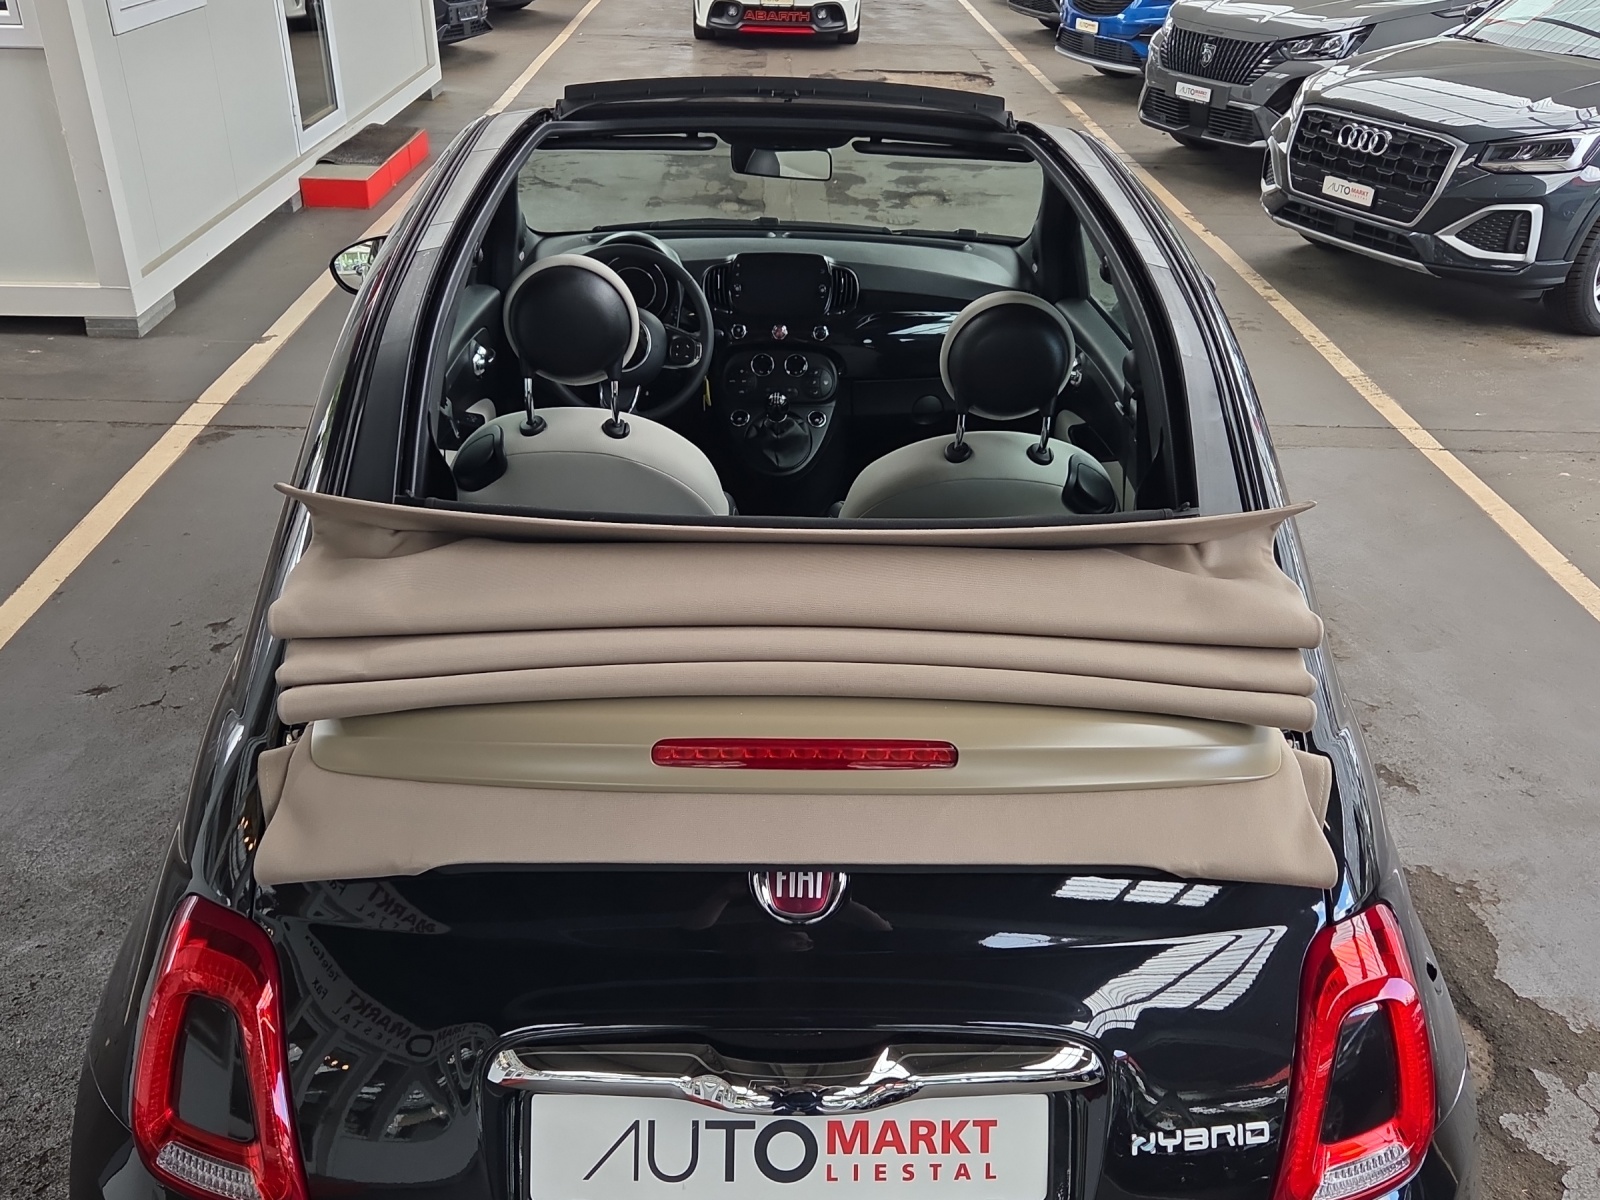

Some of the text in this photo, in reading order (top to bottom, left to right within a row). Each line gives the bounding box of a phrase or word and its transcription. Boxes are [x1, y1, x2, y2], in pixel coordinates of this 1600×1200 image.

[744, 10, 811, 22] ABARTH
[1327, 182, 1350, 195] AUTO
[1351, 187, 1369, 198] MARKT
[1131, 1121, 1270, 1156] HYBRID
[583, 1119, 998, 1183] AUTO MARKT
[827, 1162, 998, 1182] LIESTAL
